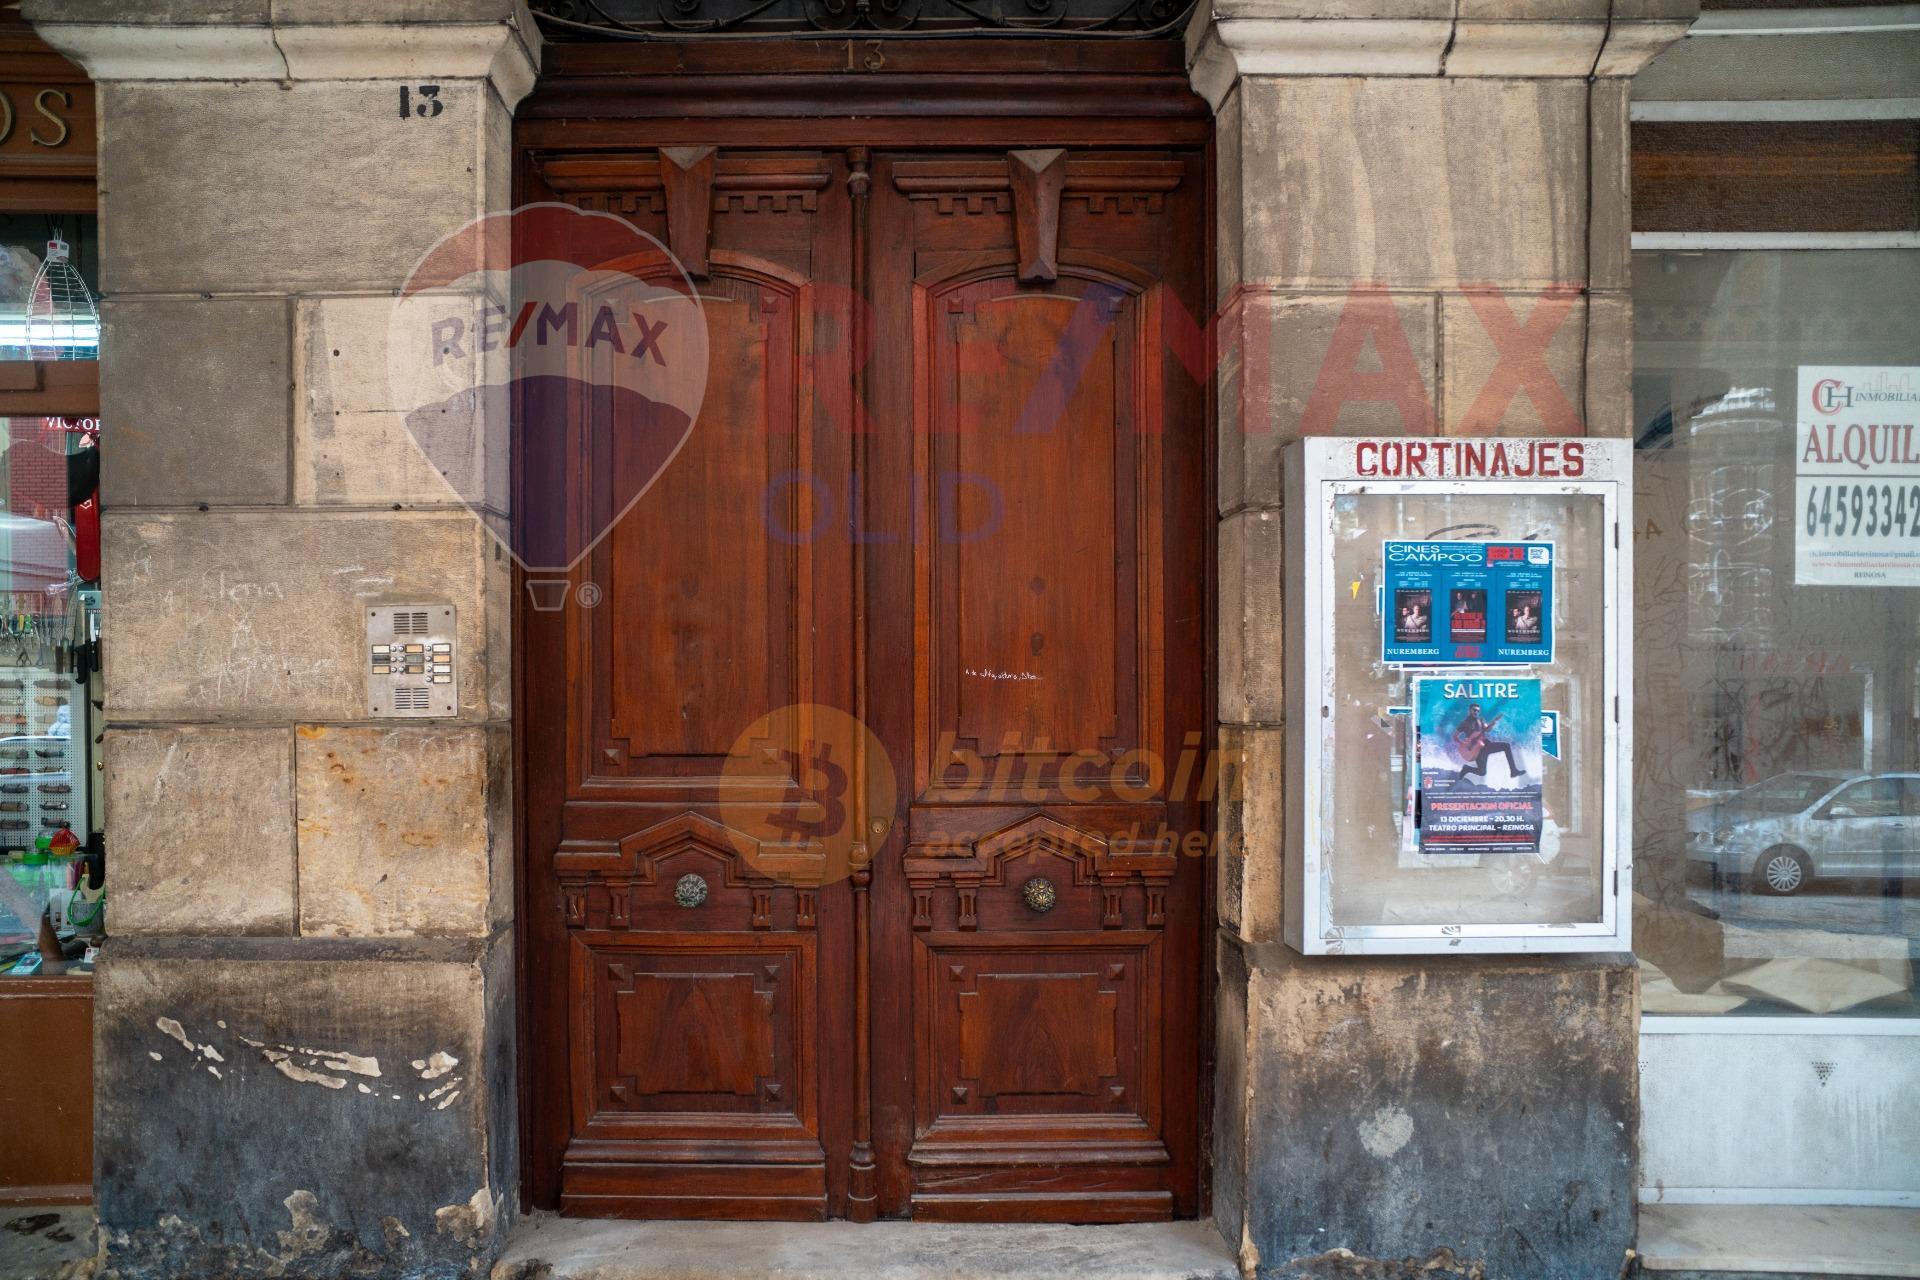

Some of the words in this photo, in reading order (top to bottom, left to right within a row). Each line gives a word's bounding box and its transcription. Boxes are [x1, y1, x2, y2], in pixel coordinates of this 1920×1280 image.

[841, 39, 885, 72] 13
[400, 86, 443, 118] 13
[0, 91, 67, 146] S
[1855, 392, 1920, 403] INMOBILIA
[1803, 424, 1920, 470] ALQUIL
[1356, 442, 1585, 477] CORTINAJES
[1807, 485, 1920, 537] 64593342
[1389, 544, 1440, 554] CINES
[1389, 552, 1483, 562] CAMPOO
[1443, 683, 1519, 699] SALITRE
[1498, 801, 1534, 810] OFICIAL
[1449, 815, 1488, 823] DICIEMBRE
